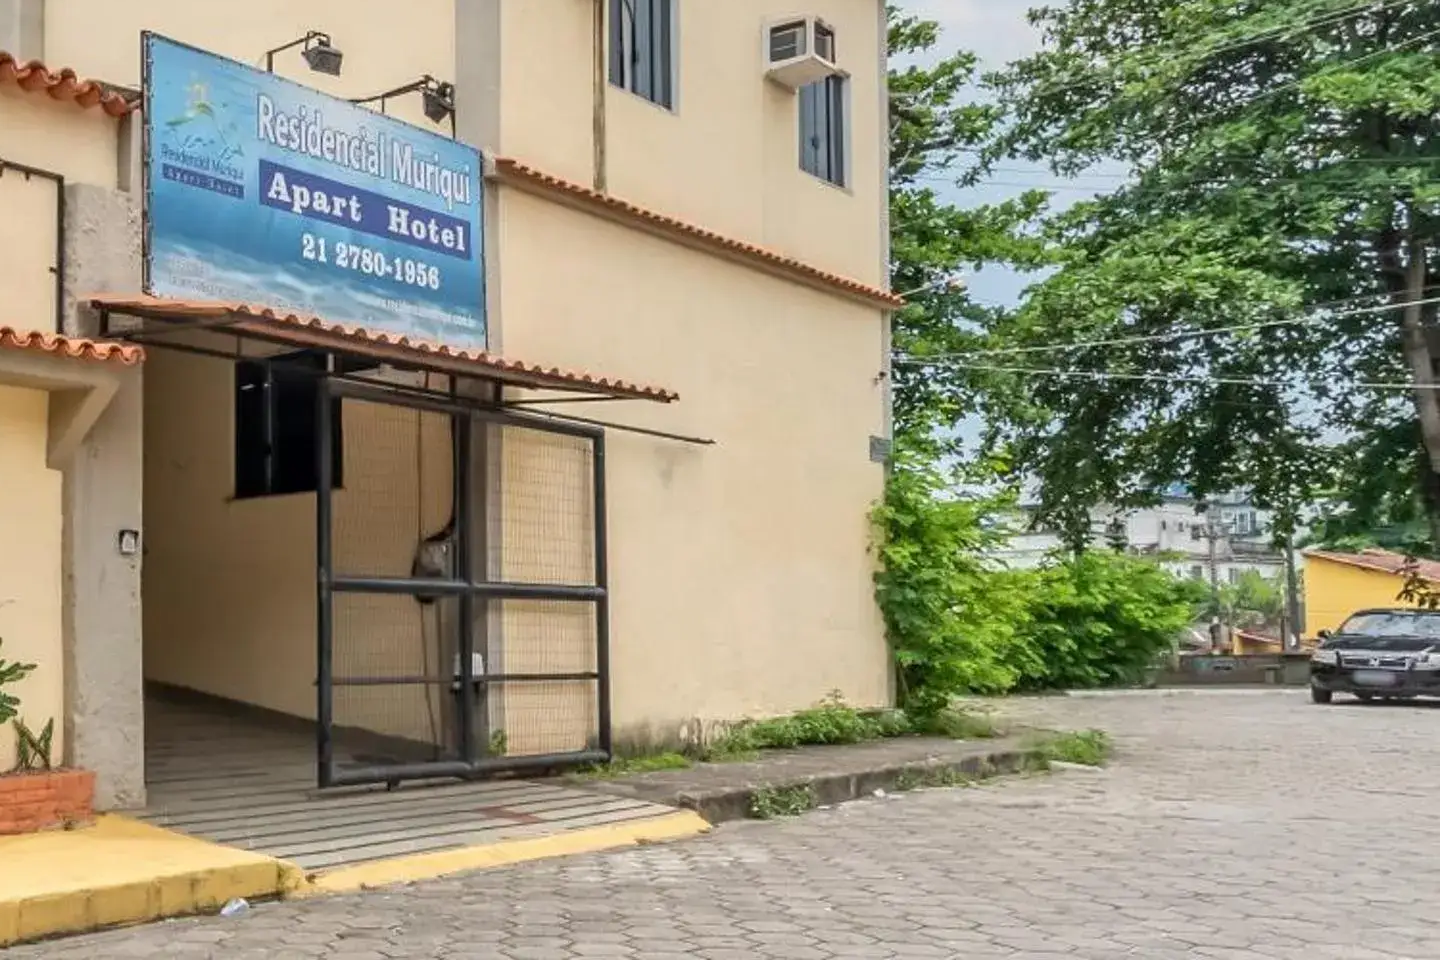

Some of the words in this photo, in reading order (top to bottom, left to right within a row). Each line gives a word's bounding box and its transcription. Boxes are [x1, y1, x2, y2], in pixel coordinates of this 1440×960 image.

[257, 93, 386, 178] Residencial
[392, 140, 471, 211] Muriqui
[267, 171, 363, 222] Apart
[387, 204, 466, 252] Hotel
[302, 232, 328, 263] 21
[335, 240, 441, 291] 2780-1956
